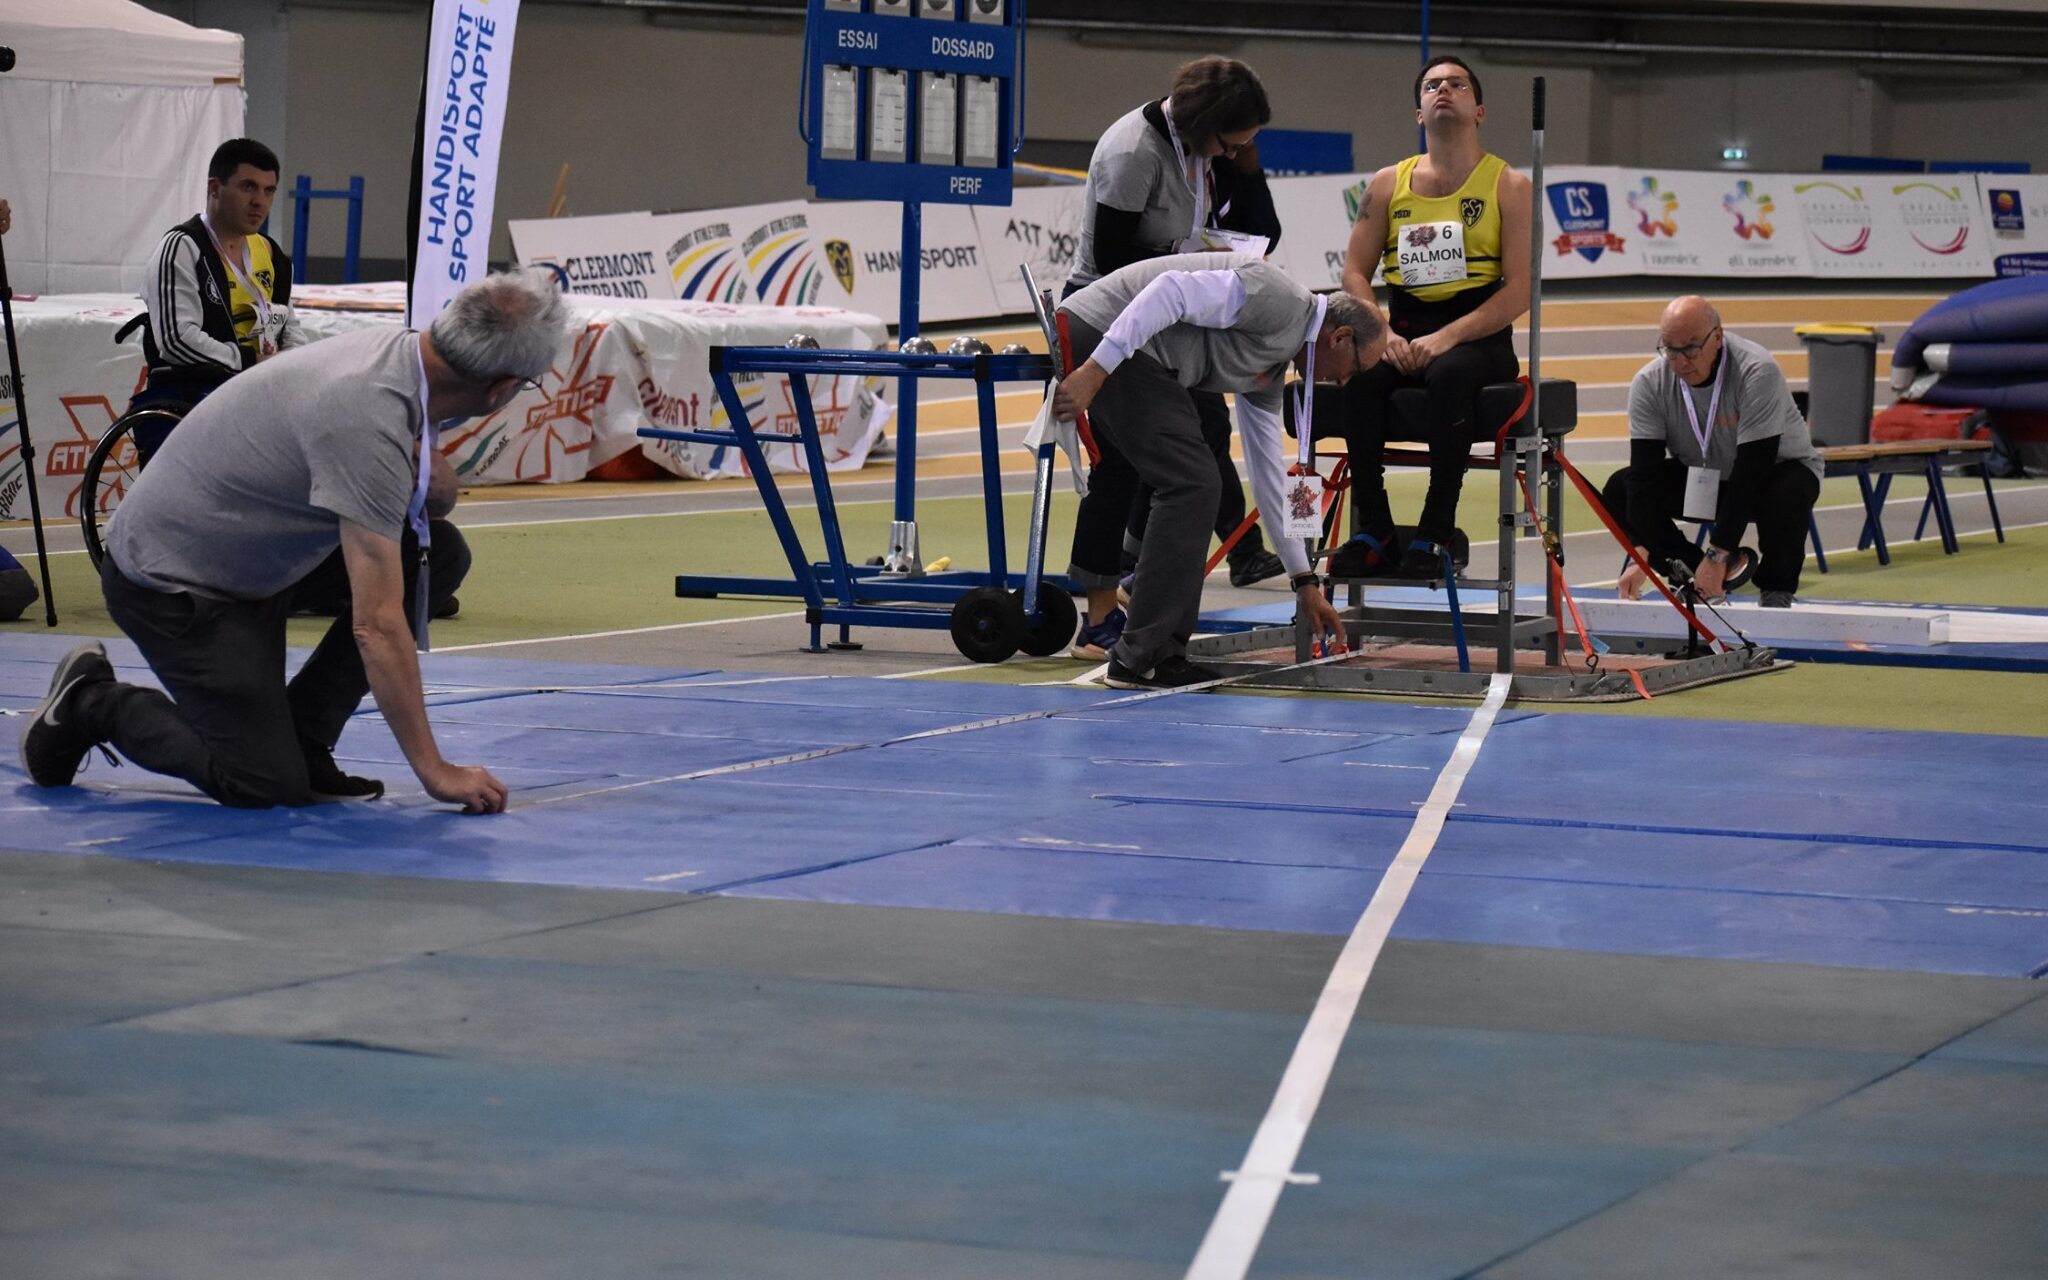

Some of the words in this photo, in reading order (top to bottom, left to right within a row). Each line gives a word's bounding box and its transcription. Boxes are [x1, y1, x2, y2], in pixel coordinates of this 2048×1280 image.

[838, 29, 878, 50] ESSAI
[932, 36, 995, 60] DOSSARD
[426, 3, 473, 246] HANDISPORT
[448, 163, 477, 284] SPORT
[463, 14, 497, 159] ADAPTÉ
[950, 176, 983, 195] PERF
[1565, 187, 1594, 217] CS
[1442, 225, 1453, 240] 6
[565, 251, 657, 282] CLERMONT
[865, 246, 978, 274] HANSPORT
[1400, 248, 1463, 265] SALMON
